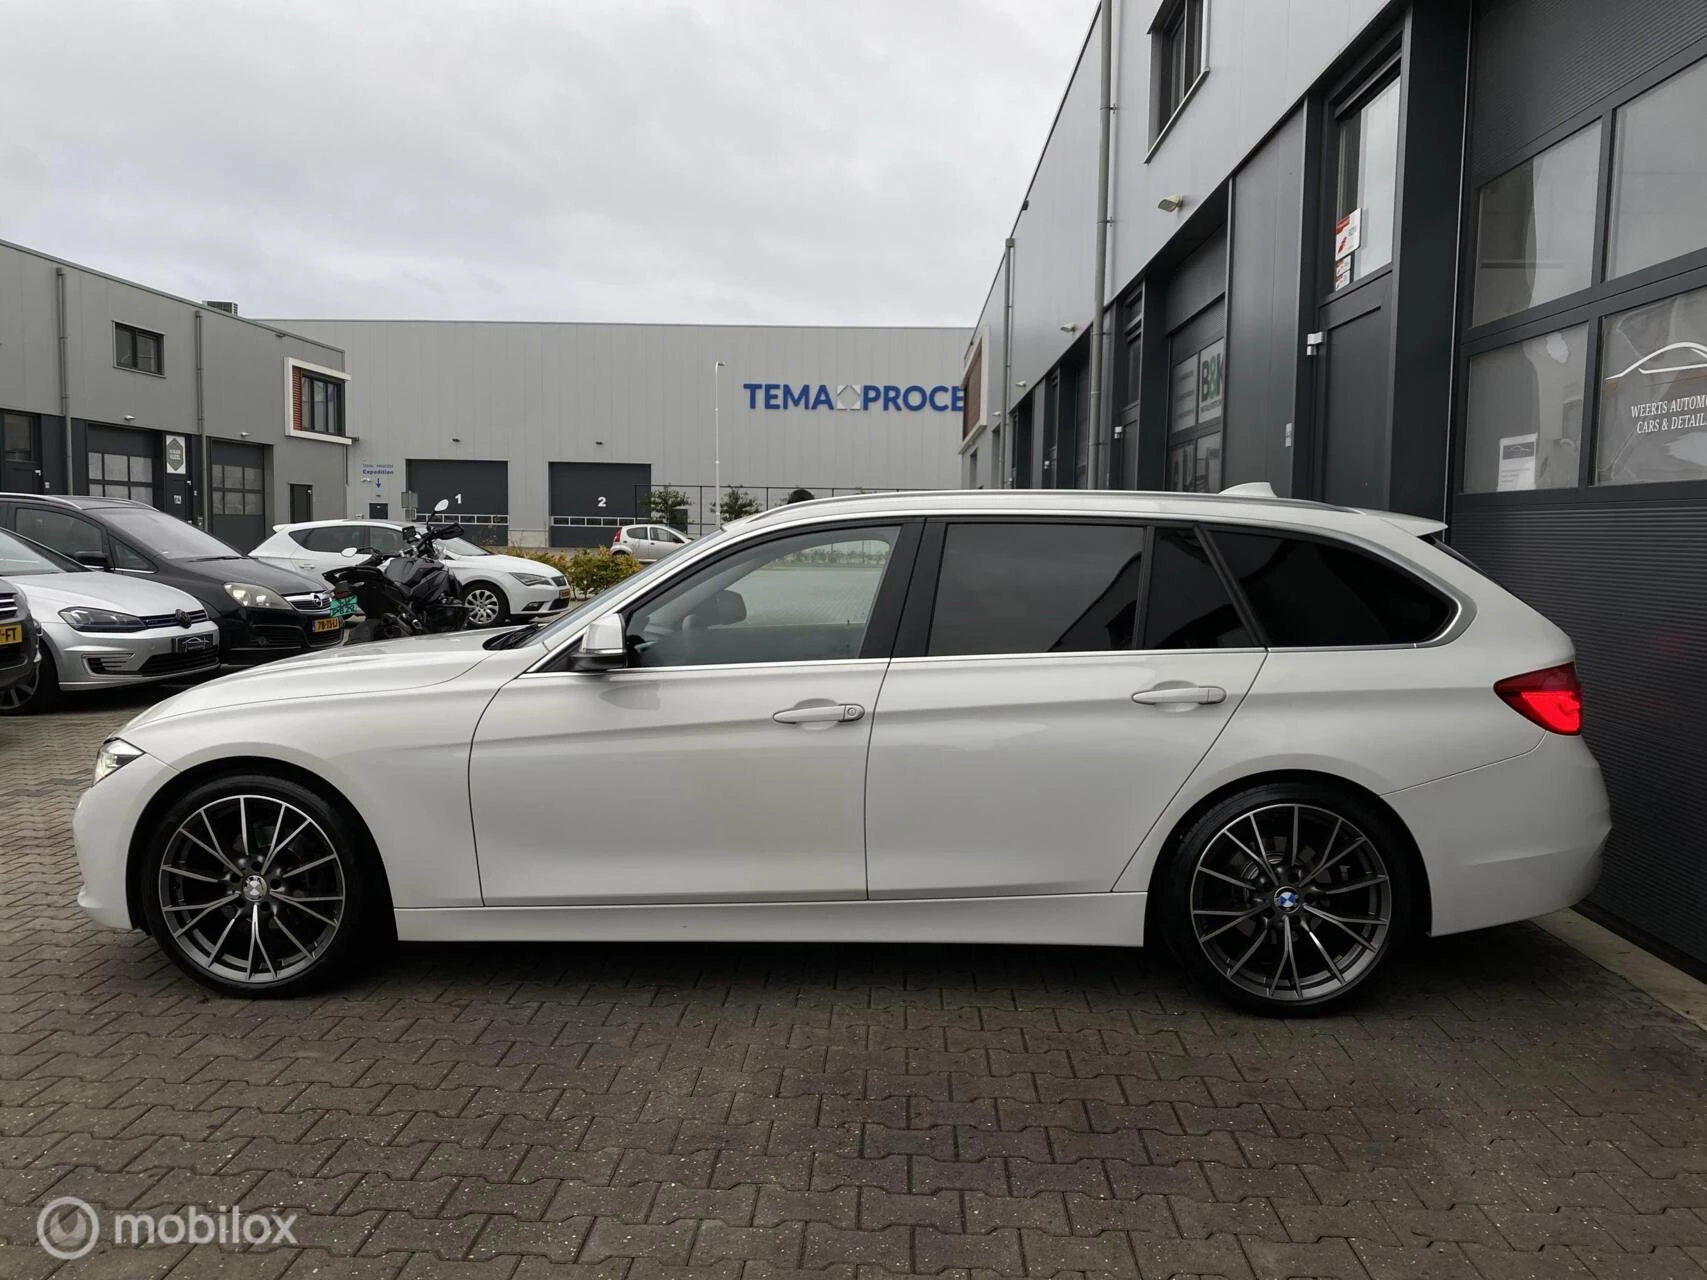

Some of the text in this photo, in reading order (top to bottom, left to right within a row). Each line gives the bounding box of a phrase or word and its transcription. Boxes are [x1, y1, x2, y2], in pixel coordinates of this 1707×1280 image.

[743, 383, 964, 412] TEMA PROCE
[1631, 400, 1668, 418] WEERTS
[1637, 412, 1707, 433] CARS & DETAIL
[454, 493, 462, 504] 1
[597, 496, 607, 507] 2
[0, 626, 16, 642] -FT
